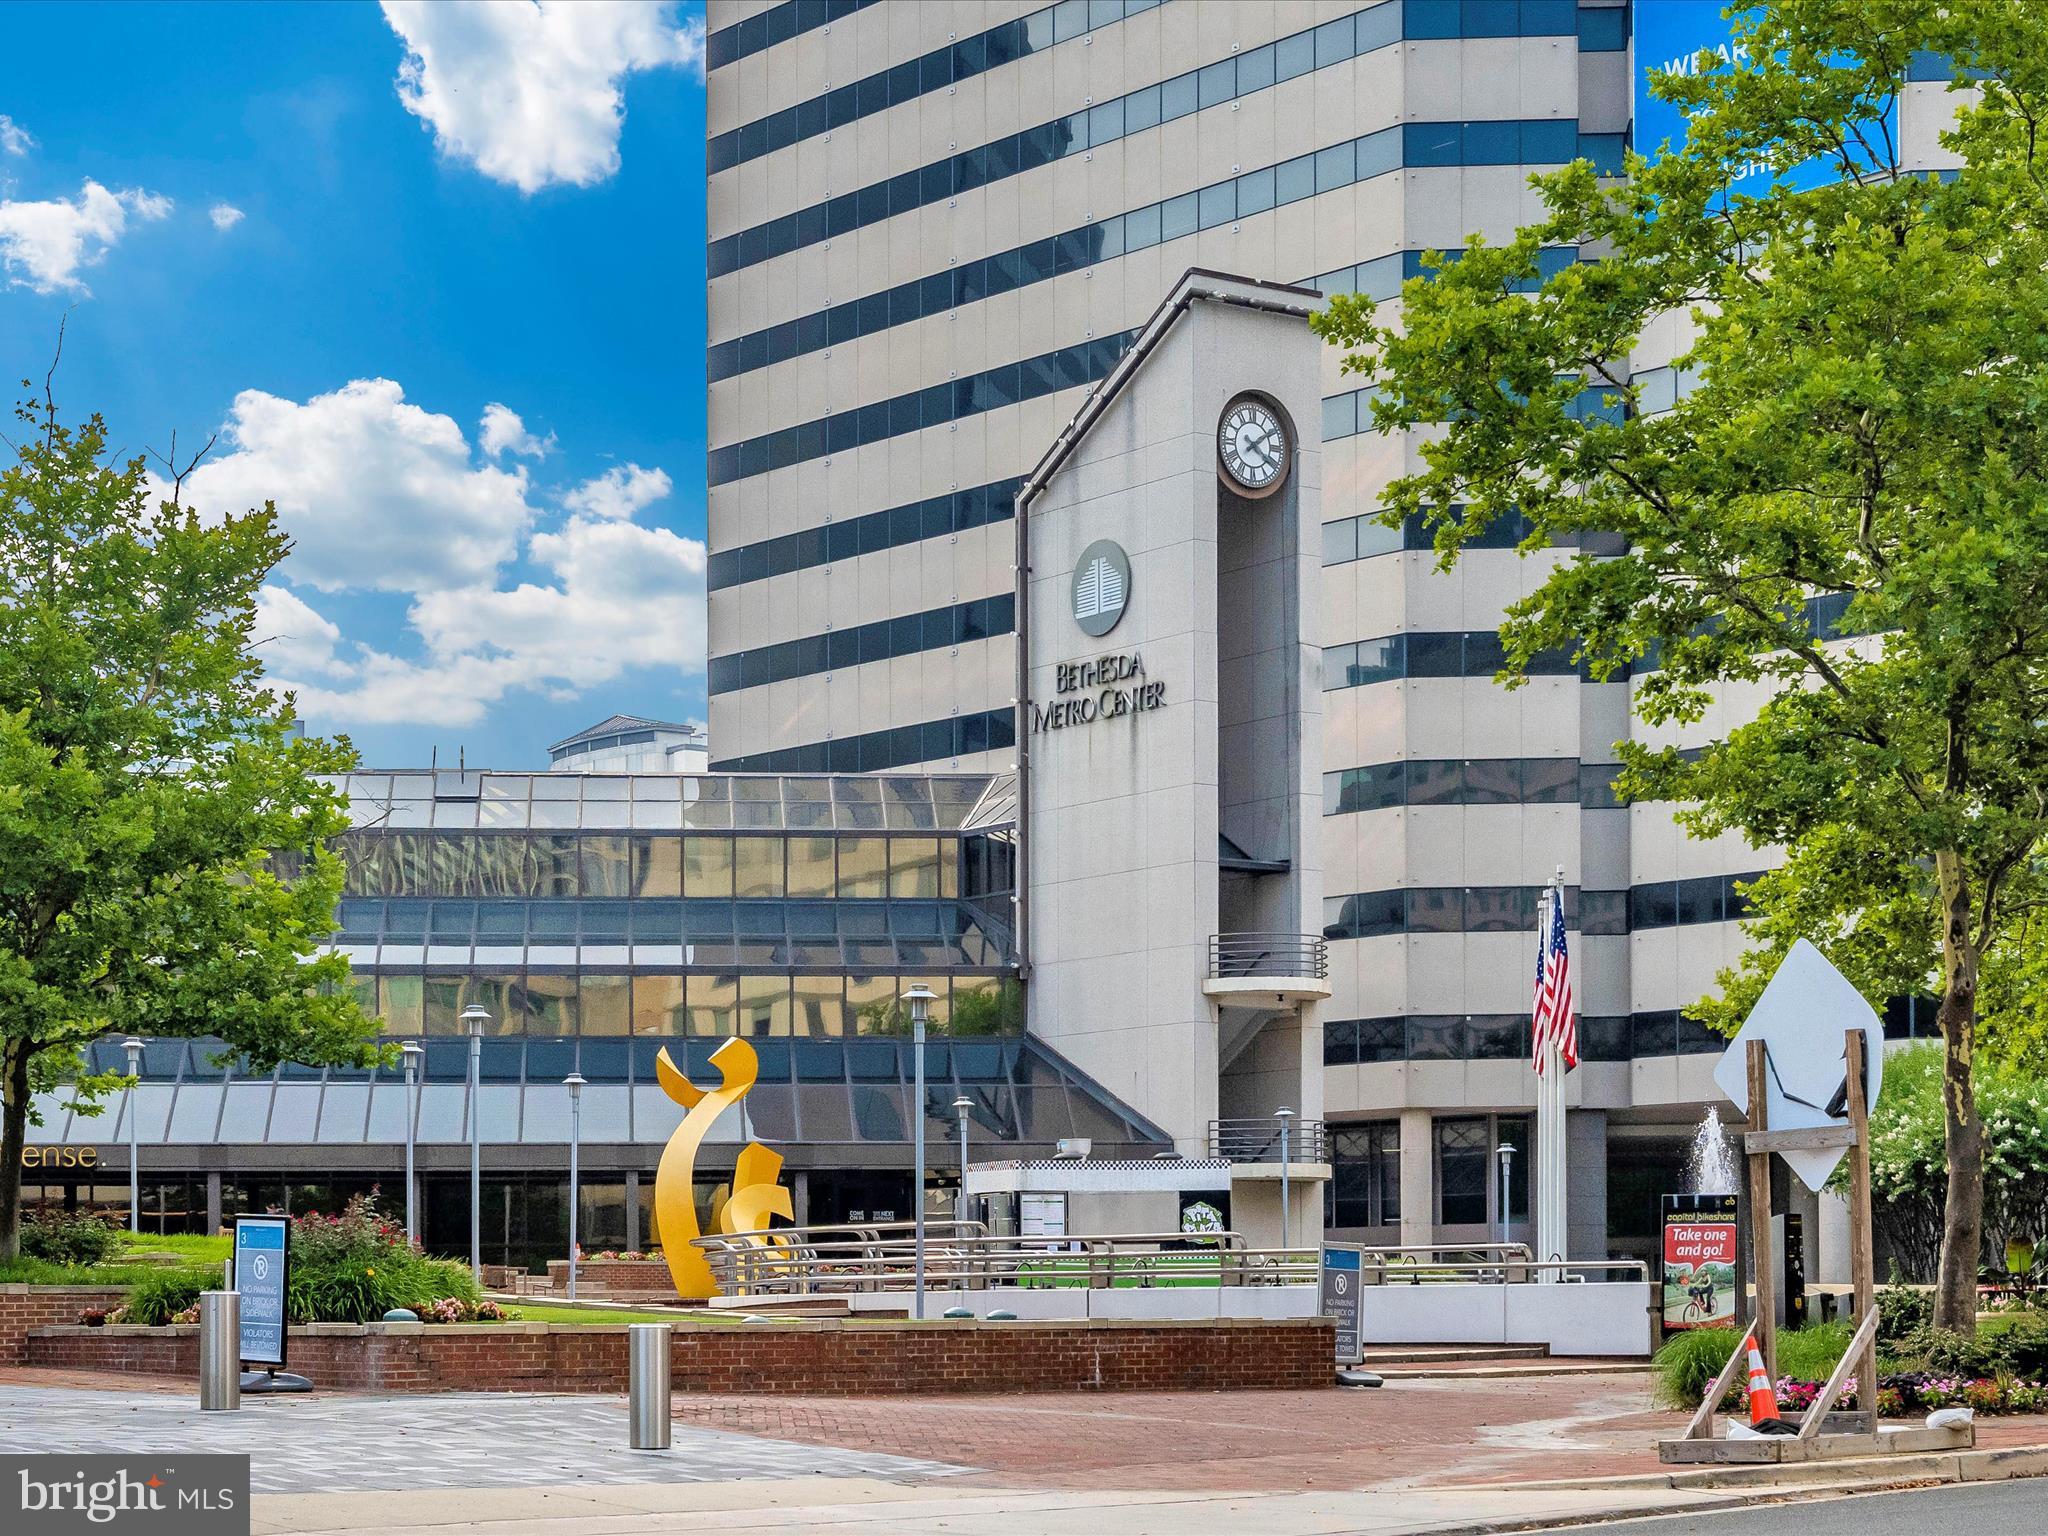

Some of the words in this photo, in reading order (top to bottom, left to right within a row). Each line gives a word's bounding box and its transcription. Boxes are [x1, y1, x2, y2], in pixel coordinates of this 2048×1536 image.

[1056, 650, 1145, 693] BETHESDA
[21, 1146, 106, 1168] ense.
[1667, 1212, 1696, 1222] capital
[1697, 1211, 1735, 1221] bikeshare
[240, 1232, 247, 1245] 3
[1673, 1228, 1702, 1241] Take
[1704, 1230, 1727, 1241] one
[1676, 1243, 1702, 1256] and
[1703, 1243, 1724, 1259] go!
[1325, 1254, 1331, 1265] 3
[242, 1285, 253, 1293] NO
[254, 1285, 278, 1295] PARKING
[241, 1296, 252, 1305] ON
[1335, 1299, 1355, 1307] PARKING
[245, 1308, 273, 1318] SIDEWALK
[1325, 1308, 1333, 1316] ON
[243, 1328, 274, 1339] VIOLATORS
[1336, 1335, 1352, 1343] ATORS
[258, 1341, 278, 1351] TOWED
[1339, 1345, 1355, 1353] TOWED
